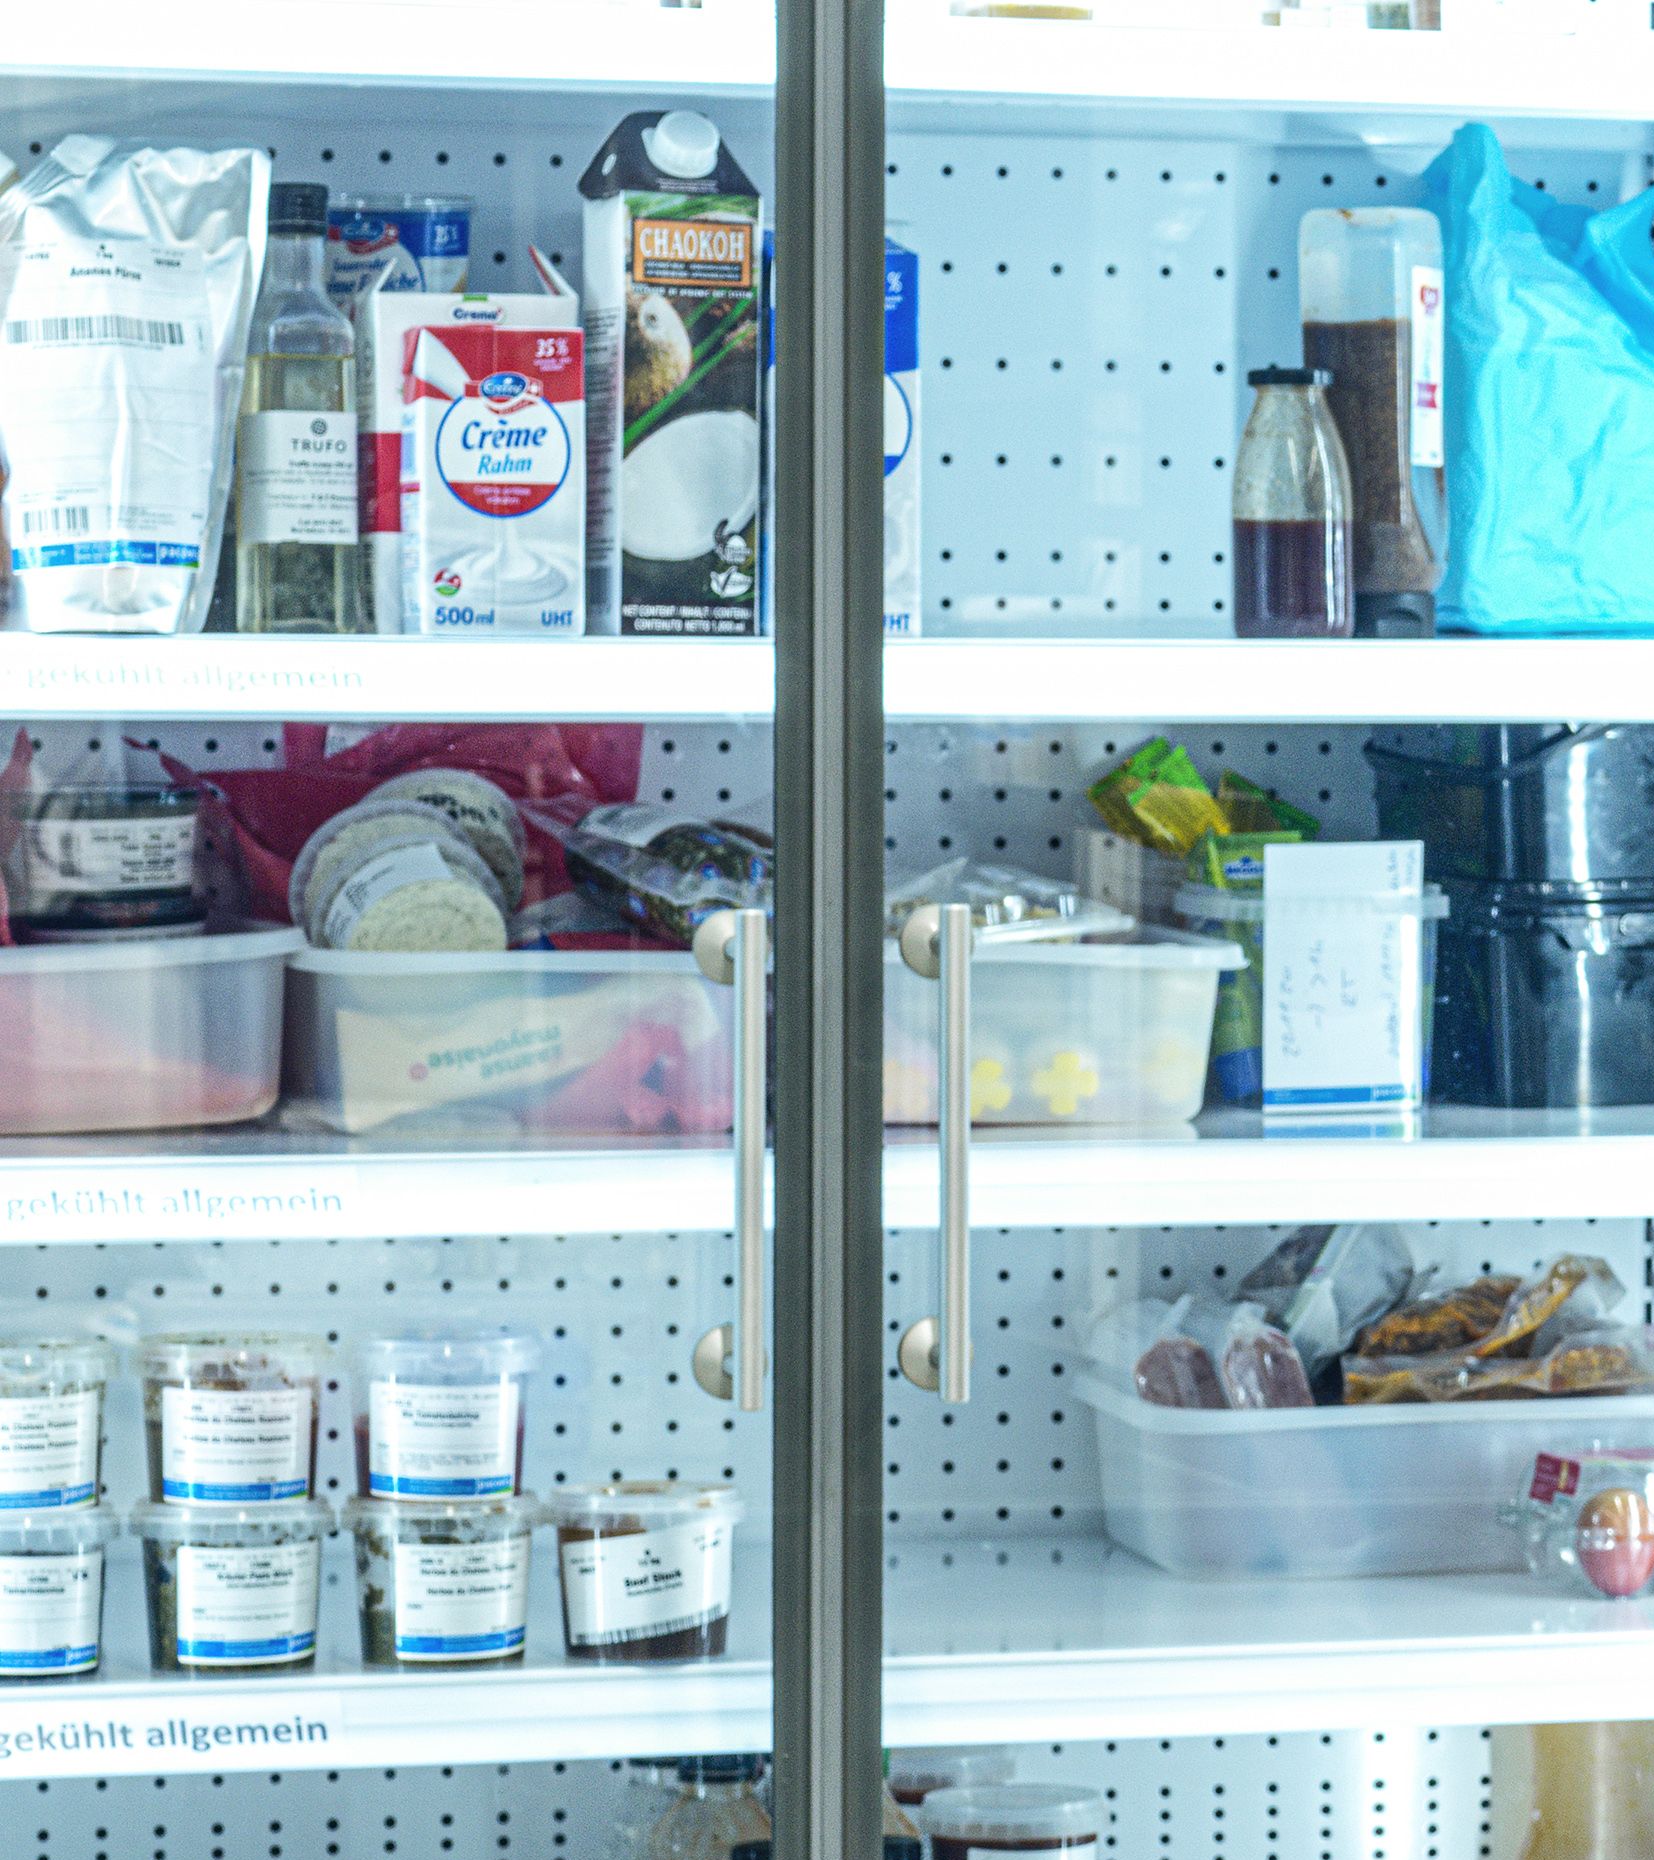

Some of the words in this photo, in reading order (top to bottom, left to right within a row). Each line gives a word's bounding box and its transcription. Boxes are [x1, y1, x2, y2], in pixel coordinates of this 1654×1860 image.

[638, 226, 746, 261] CHAOKOH
[290, 438, 348, 453] TRUFO
[461, 419, 547, 451] Crème
[477, 453, 533, 477] Rahm
[541, 609, 573, 627] UHT
[883, 612, 911, 631] HT
[6, 1189, 145, 1221] gekühlt
[161, 1187, 343, 1218] allgemein
[0, 1721, 134, 1758] gekühlt
[147, 1716, 329, 1752] allgemein
